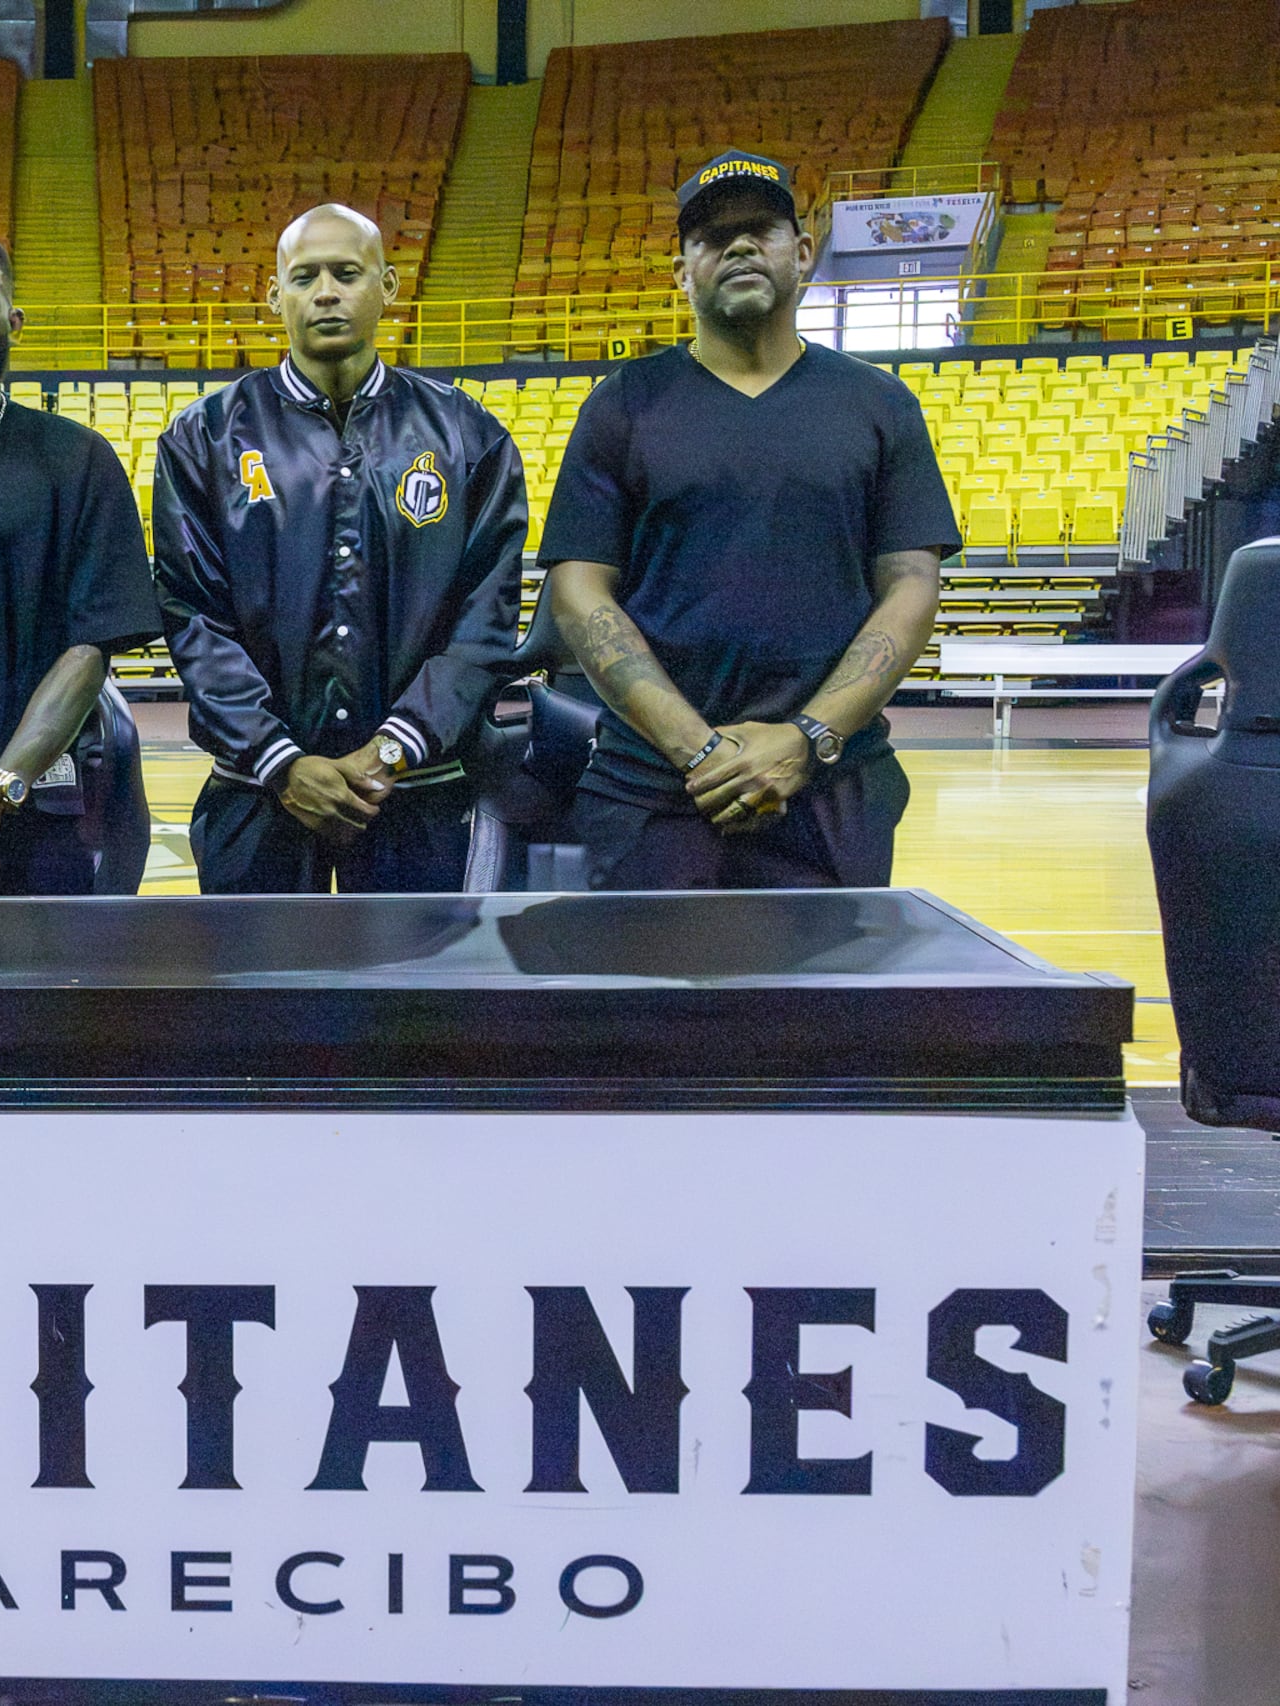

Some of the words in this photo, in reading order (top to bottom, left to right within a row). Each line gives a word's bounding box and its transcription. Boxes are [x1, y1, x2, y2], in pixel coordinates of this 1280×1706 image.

[699, 160, 780, 185] CAPITANES
[1172, 320, 1187, 338] E
[612, 341, 626, 357] D
